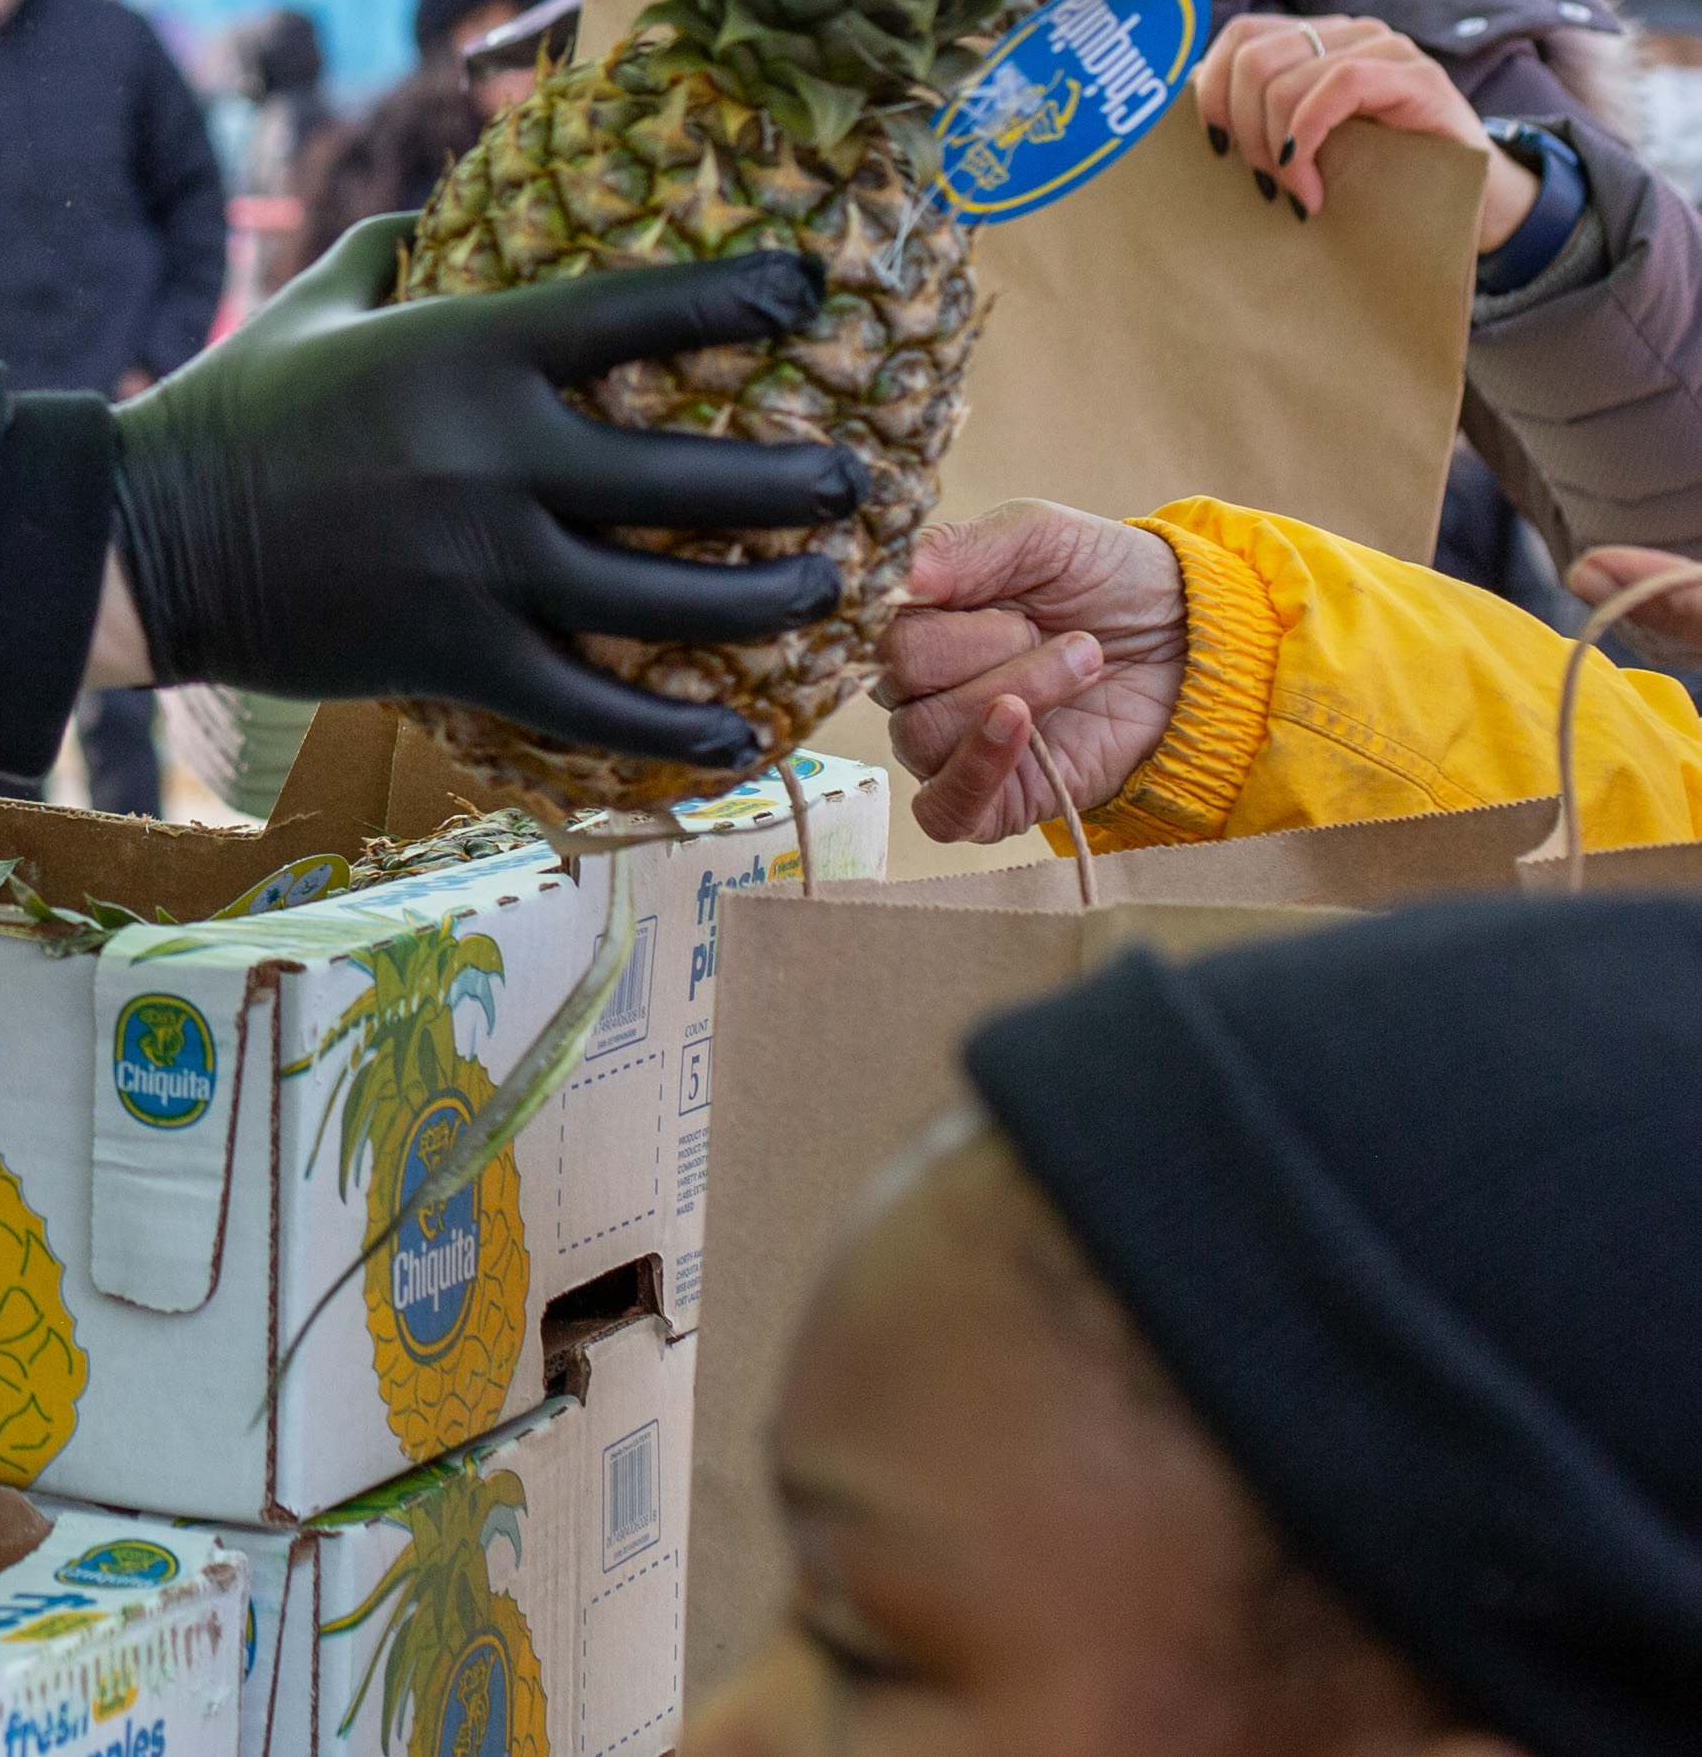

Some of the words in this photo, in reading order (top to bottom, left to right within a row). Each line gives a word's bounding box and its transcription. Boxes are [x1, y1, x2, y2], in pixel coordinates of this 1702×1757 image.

[688, 925, 716, 1001] pi
[685, 1018, 709, 1038] COUNT
[117, 1060, 211, 1107] Chiquita
[688, 1054, 700, 1101] 5
[394, 1227, 475, 1313] Chiquita
